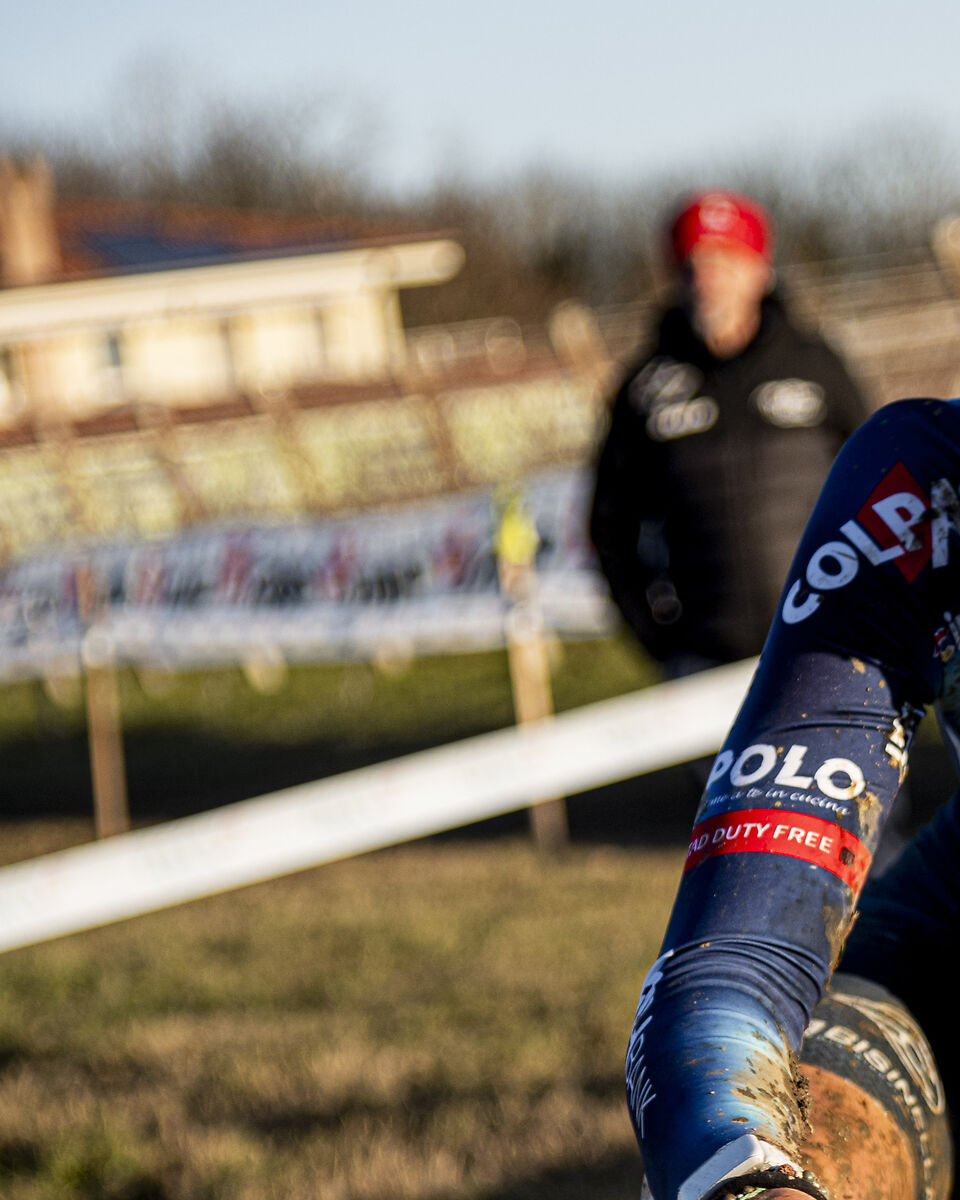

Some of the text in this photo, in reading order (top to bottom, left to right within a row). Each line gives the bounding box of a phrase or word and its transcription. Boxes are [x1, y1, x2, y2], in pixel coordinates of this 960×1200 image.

[706, 744, 866, 801] POLO
[790, 790, 851, 816] cucina
[712, 822, 771, 844] DUTY
[772, 824, 834, 855] FREE
